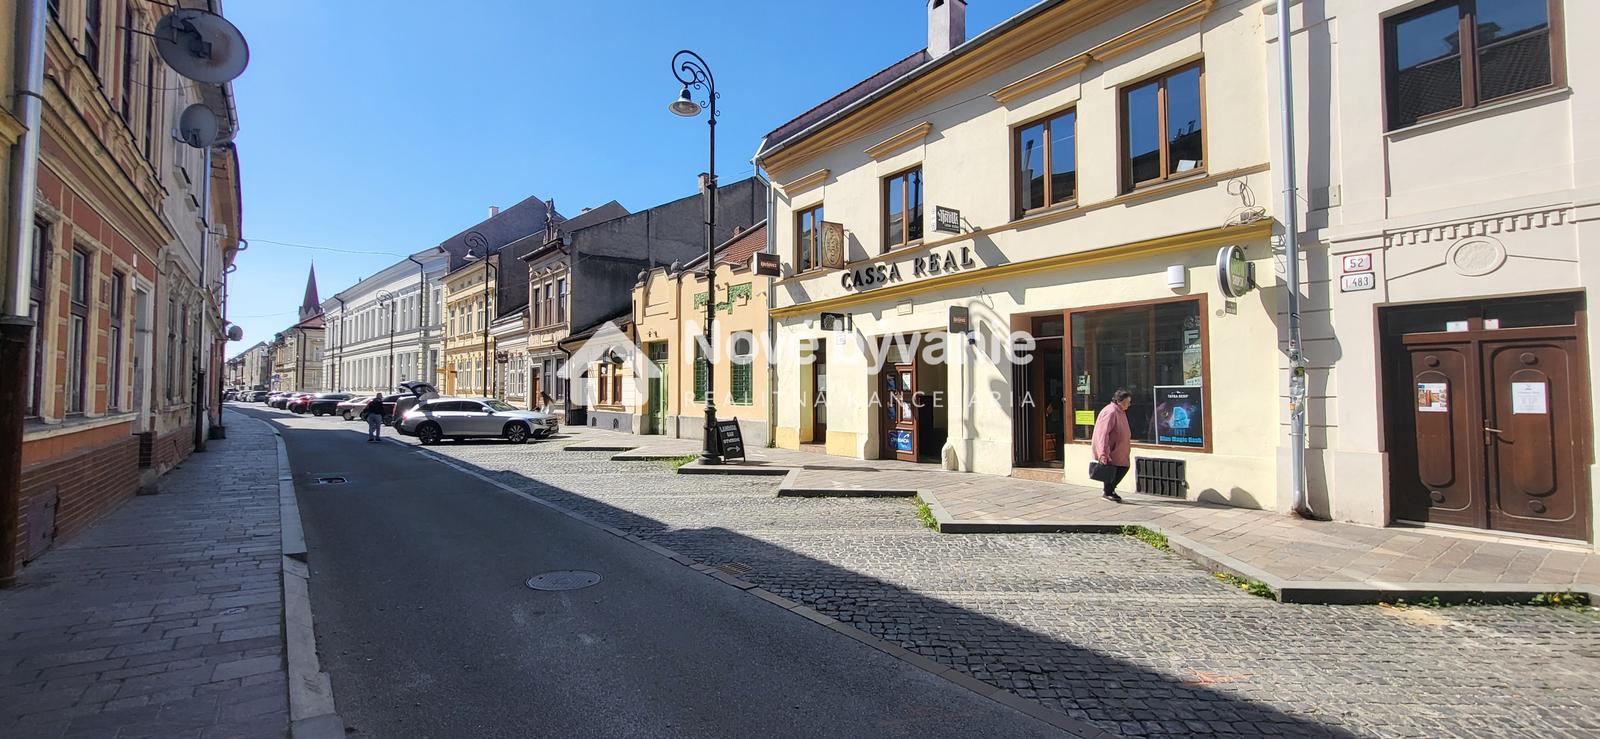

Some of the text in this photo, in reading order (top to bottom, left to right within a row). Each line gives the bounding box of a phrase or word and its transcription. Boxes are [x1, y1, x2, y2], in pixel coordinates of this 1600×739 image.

[841, 246, 976, 291] CASSA REAL
[1350, 257, 1364, 268] 52
